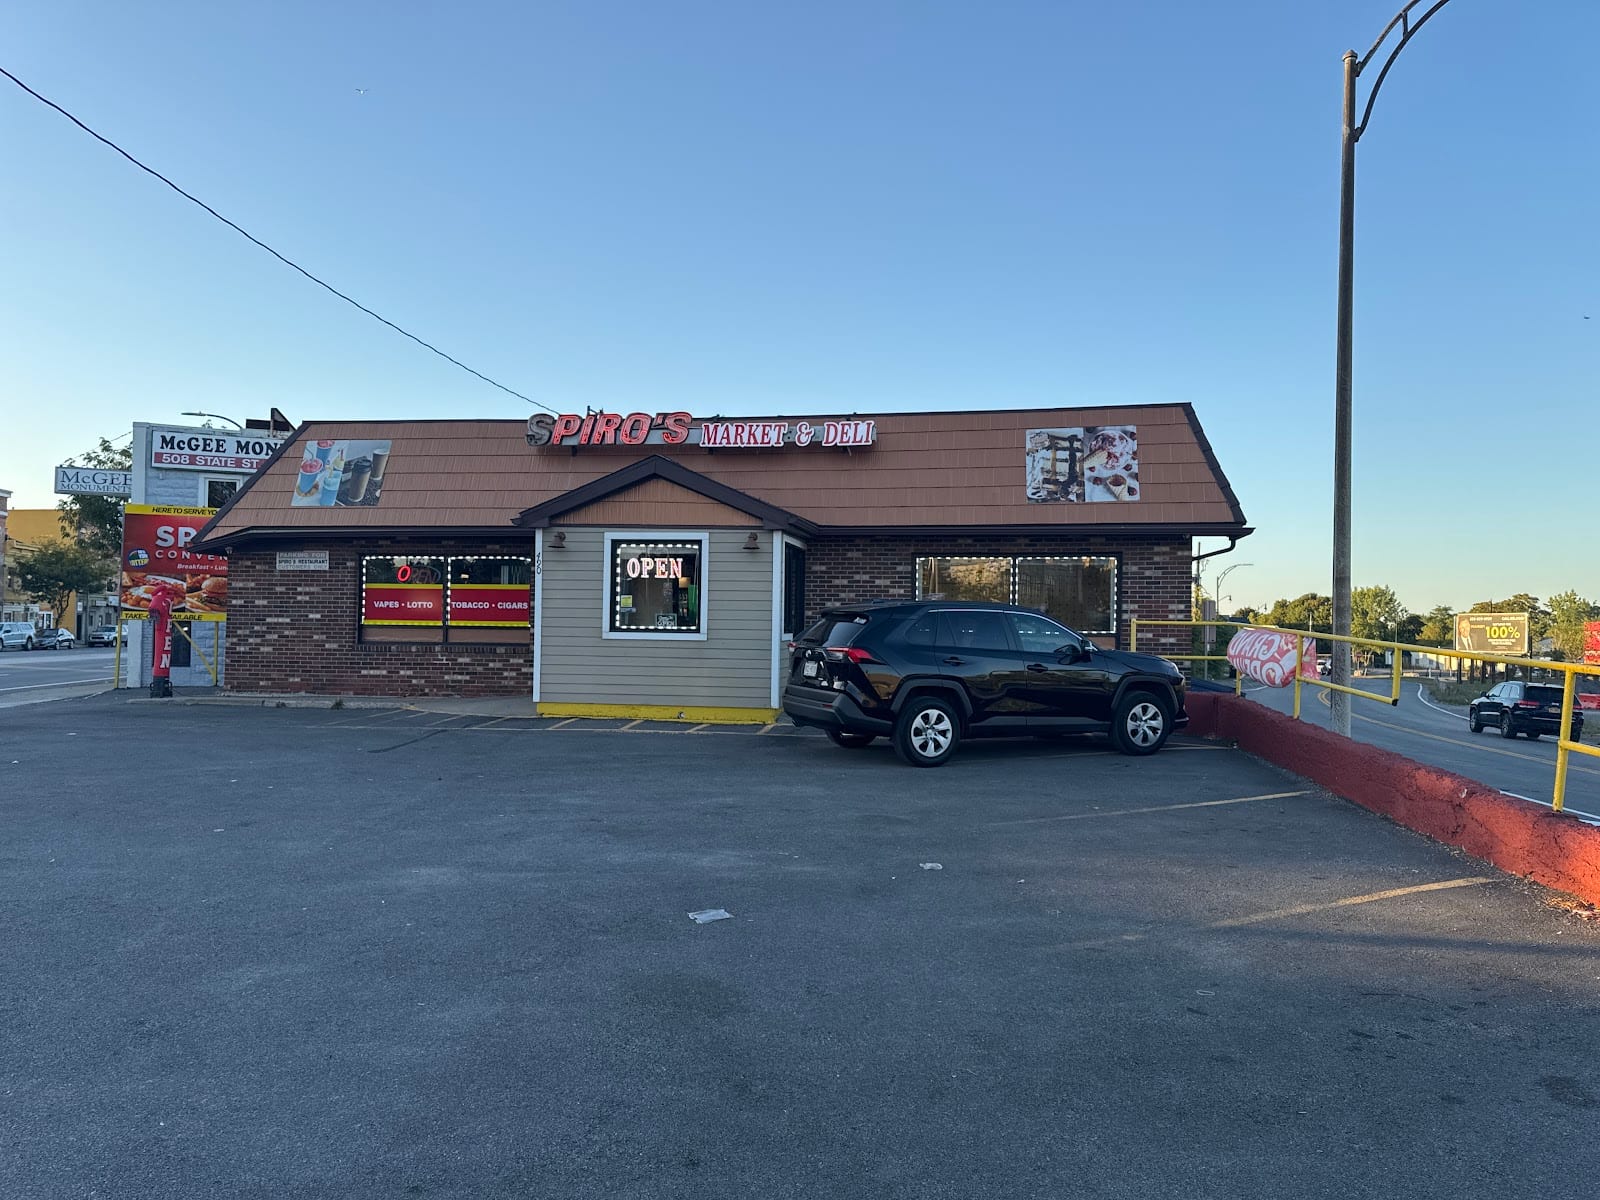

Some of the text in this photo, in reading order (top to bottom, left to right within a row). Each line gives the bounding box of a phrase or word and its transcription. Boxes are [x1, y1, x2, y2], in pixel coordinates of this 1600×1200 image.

[527, 412, 875, 447] SPIRO'S MARKET & DELI
[160, 435, 227, 454] McGEE
[161, 453, 260, 469] 508 STATE ST
[60, 470, 132, 486] McGEE
[626, 558, 683, 579] OPEN
[407, 601, 433, 609] LOTTO
[451, 601, 490, 609] TOBACCO
[1486, 626, 1521, 639] 100%
